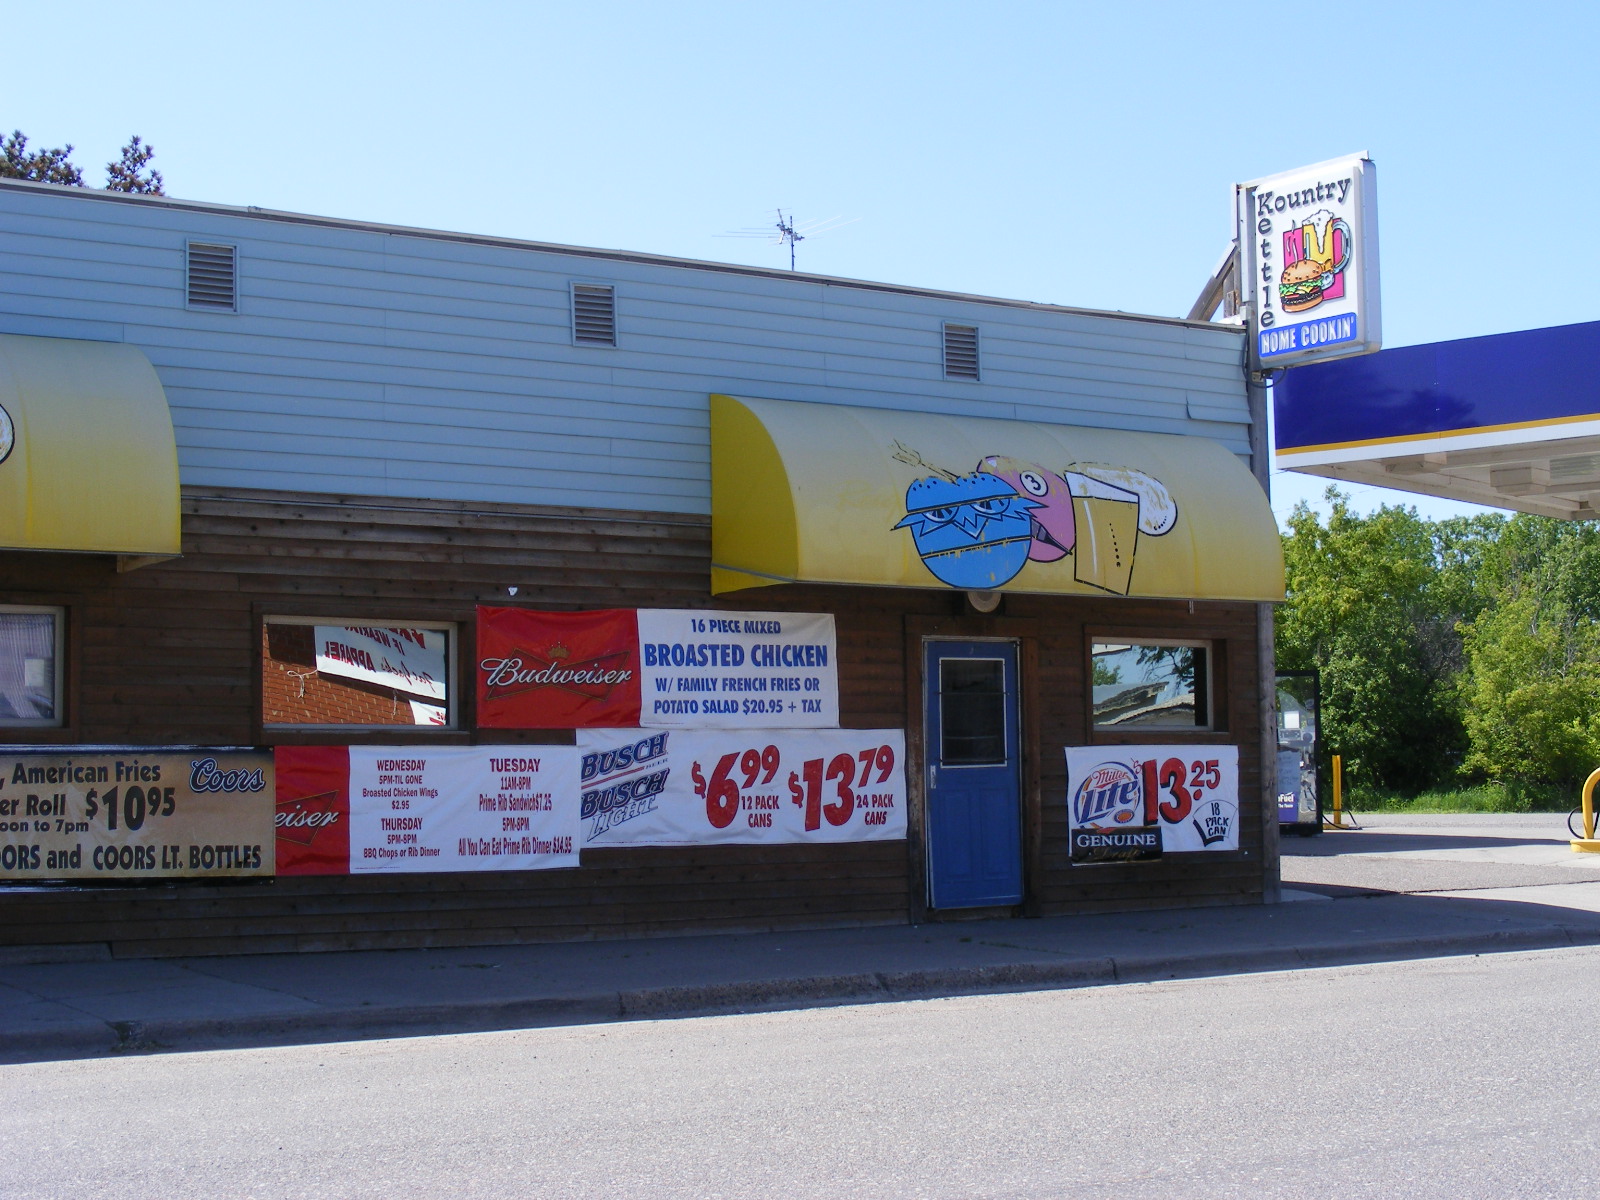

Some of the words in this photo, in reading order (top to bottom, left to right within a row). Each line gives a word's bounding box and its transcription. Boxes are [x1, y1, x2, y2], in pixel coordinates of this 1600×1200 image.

[1257, 177, 1351, 216] Kountry
[1261, 327, 1297, 354] HOME
[1301, 315, 1354, 347] COOKIN'
[691, 619, 706, 633] 16
[709, 619, 741, 633] PIECE
[744, 620, 781, 634] MIXED
[644, 643, 745, 667] BROASTED
[750, 644, 828, 667] CHICKEN
[480, 657, 632, 686] Budweiser
[655, 677, 673, 693] W/
[677, 677, 718, 692] FAMILY
[722, 677, 767, 692] FRENCH
[771, 677, 801, 692] FRIES
[804, 677, 820, 692] OR
[654, 699, 699, 714] POTATO
[702, 699, 739, 714] SALAD
[742, 698, 783, 715] $20.95
[787, 701, 797, 712] +
[802, 699, 822, 713] TAX
[581, 731, 669, 783] BUSCH
[11, 760, 109, 784] American
[115, 760, 161, 783] Fries
[376, 759, 427, 772] WEDNESDAY
[489, 758, 541, 773] TUESDAY
[189, 757, 266, 793] Coors
[379, 775, 404, 785] 5PM-TIL
[405, 775, 423, 785] GONE
[1092, 770, 1128, 786] Miller
[500, 776, 531, 791] 11AM-8PM
[362, 787, 392, 798] Broasted
[393, 787, 418, 798] Chicken
[419, 787, 439, 799] Wings
[581, 767, 670, 820] BUSCH
[26, 793, 66, 816] Roll
[391, 800, 410, 810] $2.95
[478, 793, 497, 812] Prime
[497, 793, 507, 812] Rib
[741, 795, 753, 809] 12
[755, 795, 780, 809] PACK
[856, 795, 869, 808] 24
[872, 794, 894, 808] PACK
[1079, 780, 1139, 824] Lite
[1210, 802, 1220, 816] 18
[381, 817, 423, 831] THURSDAY
[502, 817, 530, 832] 5PM-8PM
[587, 794, 658, 842] LIGHT
[748, 813, 772, 828] CANS
[864, 811, 887, 825] CANS
[1205, 817, 1230, 828] PACK
[34, 820, 51, 832] to
[55, 819, 89, 835] 7pm
[1208, 826, 1227, 837] CAN
[387, 833, 418, 845] 5PM-8PM
[458, 838, 467, 856] All
[467, 838, 478, 856] You
[479, 837, 491, 856] Can
[491, 837, 502, 856] Eat
[503, 837, 520, 855] Prime
[521, 836, 532, 855] Rib
[532, 836, 552, 855] Dinner
[1077, 834, 1156, 848] GENUINE
[0, 844, 41, 870] ORS
[46, 844, 82, 869] and
[93, 845, 155, 870] COORS
[161, 845, 184, 869] LT.
[189, 845, 261, 869] BOTTLES
[363, 847, 377, 859] BBQ
[378, 847, 399, 860] Chops
[400, 848, 407, 857] or
[408, 846, 418, 857] Rib
[420, 846, 441, 857] Dinner
